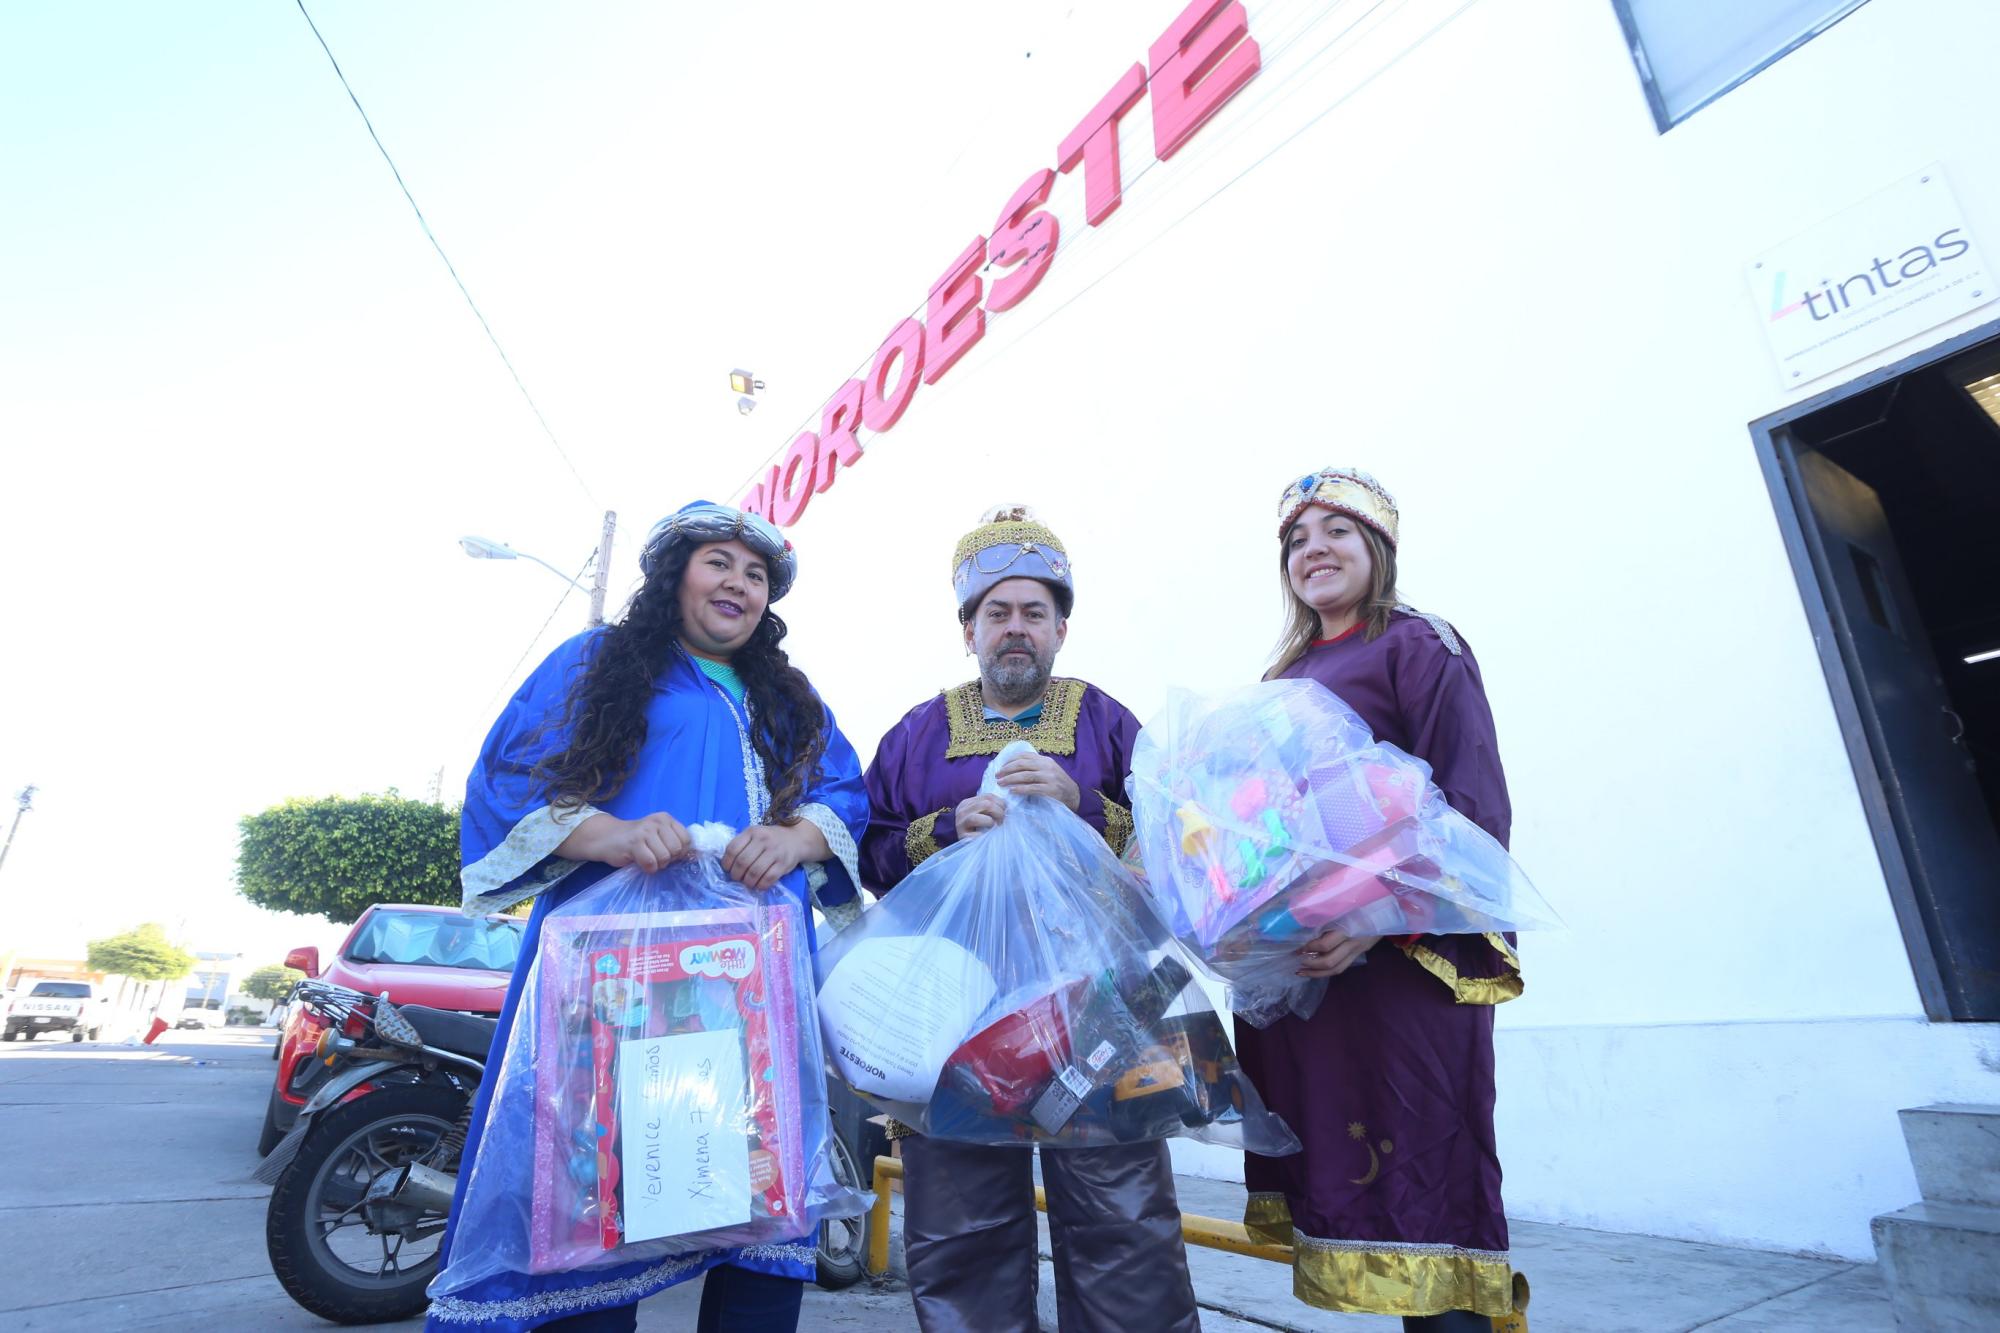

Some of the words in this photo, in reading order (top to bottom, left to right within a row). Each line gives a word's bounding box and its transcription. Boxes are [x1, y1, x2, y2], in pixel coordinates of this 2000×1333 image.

[740, 0, 1262, 527] NOROESTE
[23, 1003, 72, 1012] NISSAN
[840, 1046, 886, 1080] NOROESTE
[688, 1132, 714, 1199] Ximena
